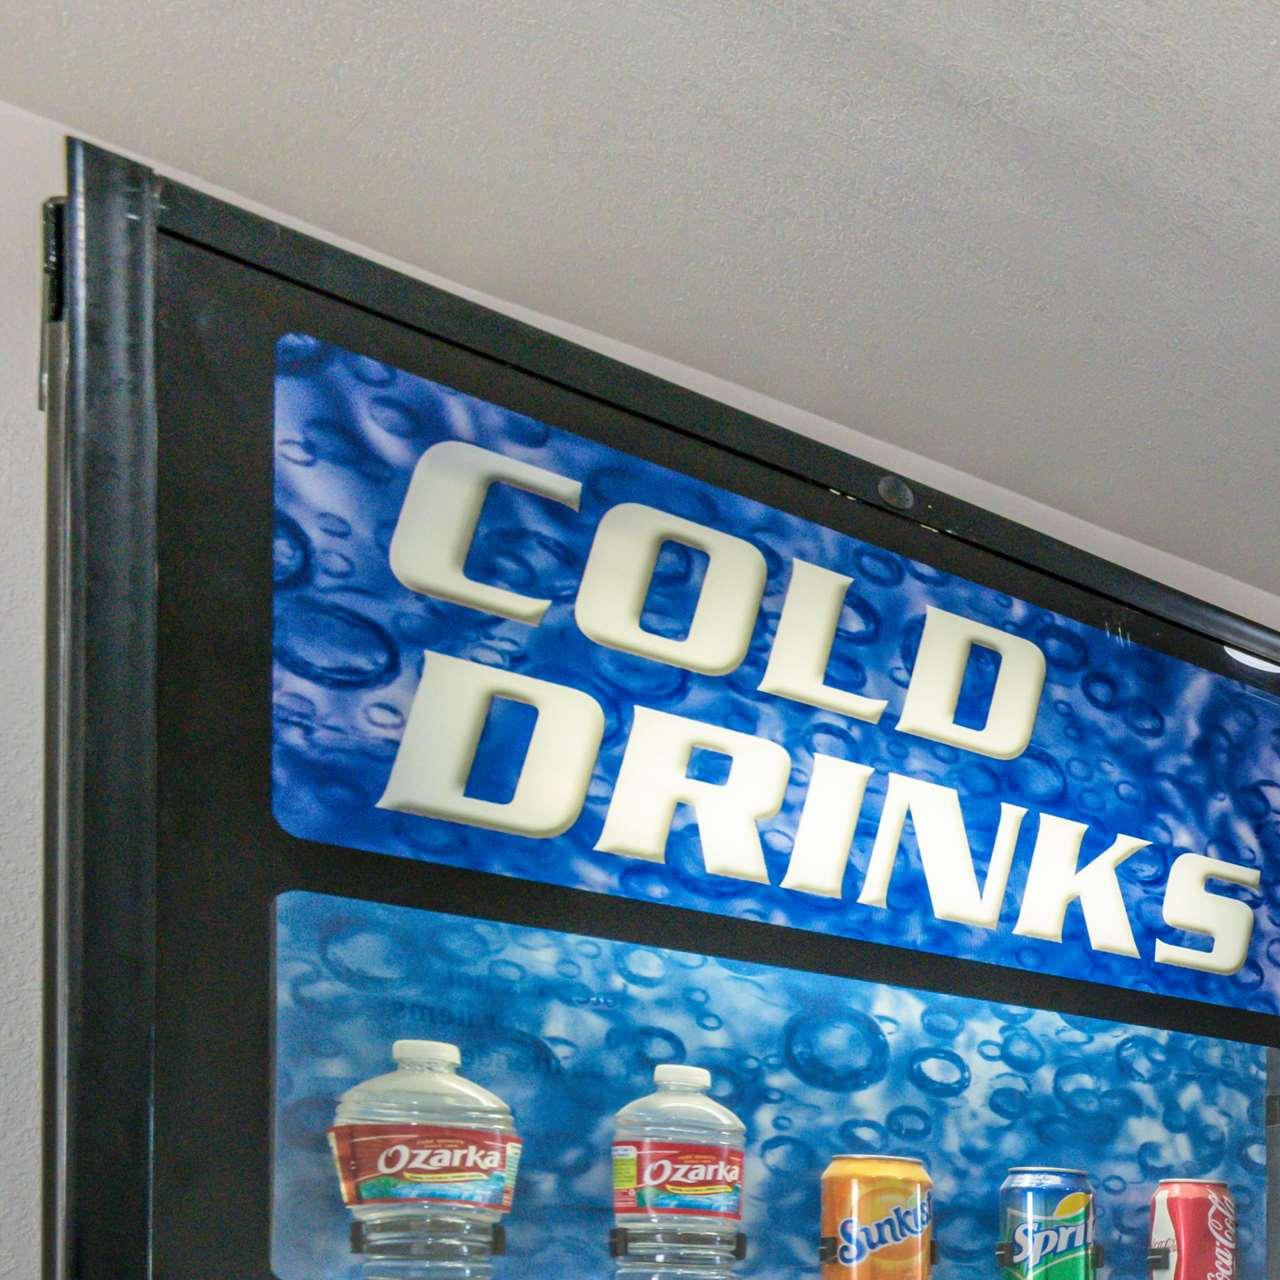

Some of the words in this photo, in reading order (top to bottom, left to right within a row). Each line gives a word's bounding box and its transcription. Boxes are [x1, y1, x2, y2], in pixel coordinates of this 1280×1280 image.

[388, 440, 1046, 760] COLD
[377, 649, 1261, 977] DRINKS
[377, 1145, 501, 1174] Ozarka
[643, 1159, 740, 1185] Ozarka
[1013, 1215, 1094, 1269] Sprit
